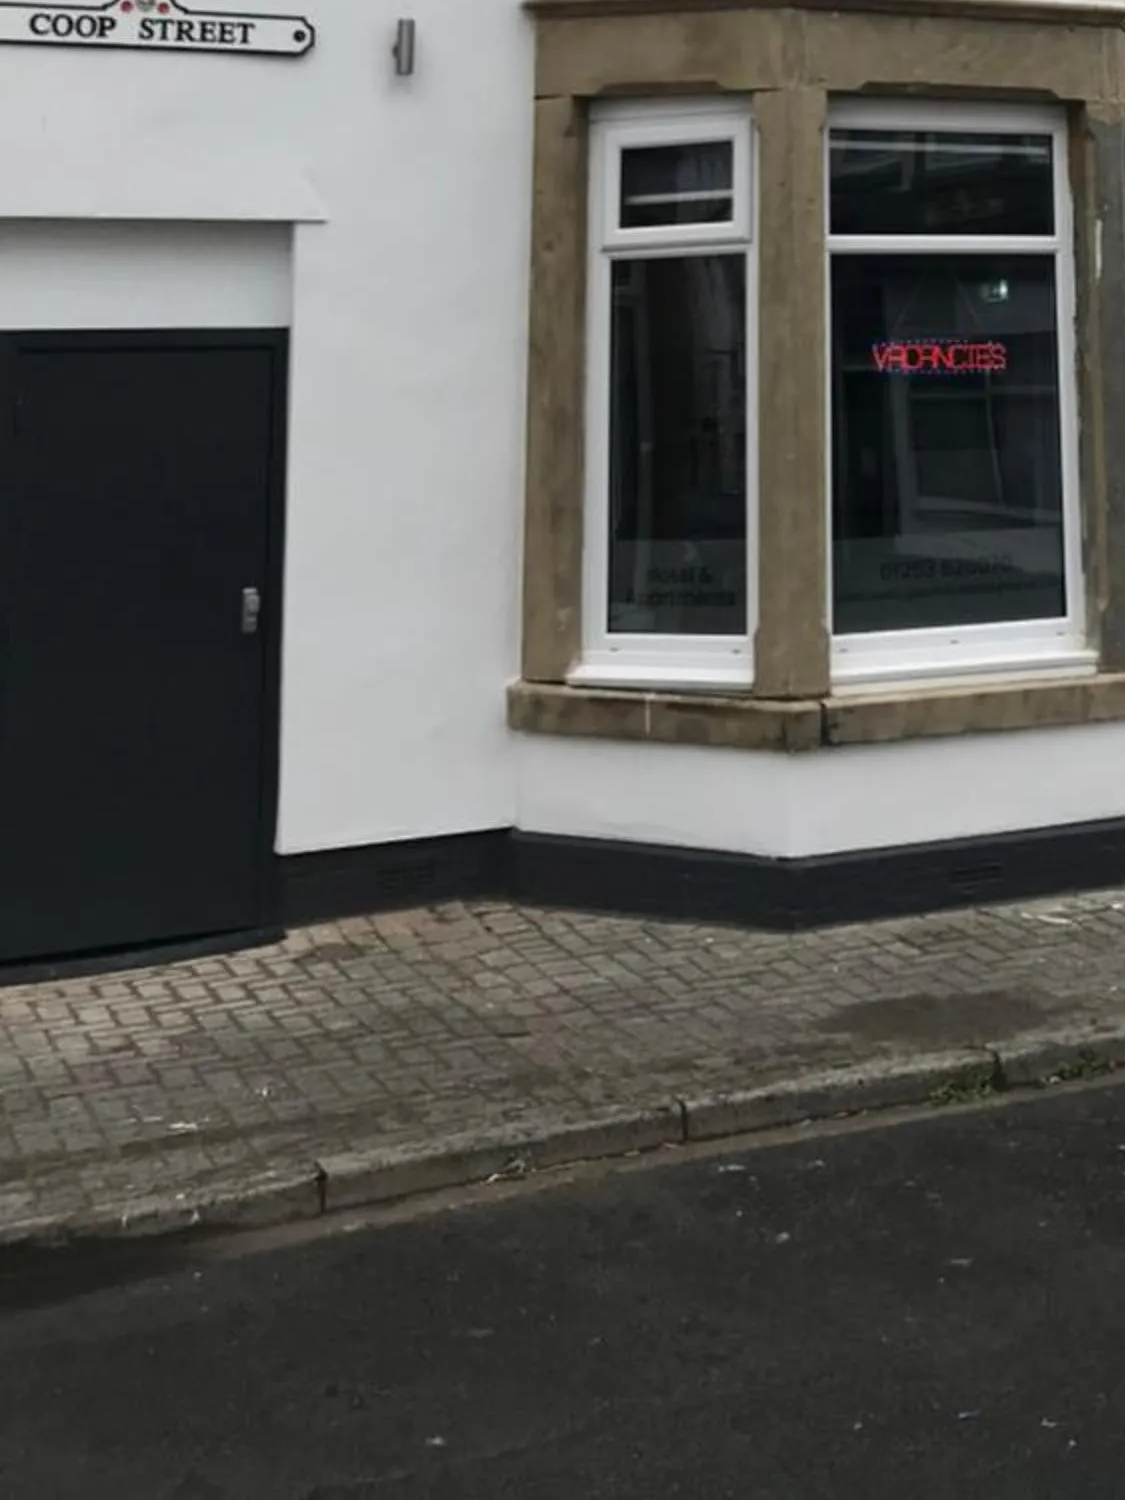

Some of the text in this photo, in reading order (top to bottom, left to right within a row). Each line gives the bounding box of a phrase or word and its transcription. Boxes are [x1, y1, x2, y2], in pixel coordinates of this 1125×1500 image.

[29, 12, 256, 45] COOP STREET
[871, 340, 1007, 374] VACANCIES
